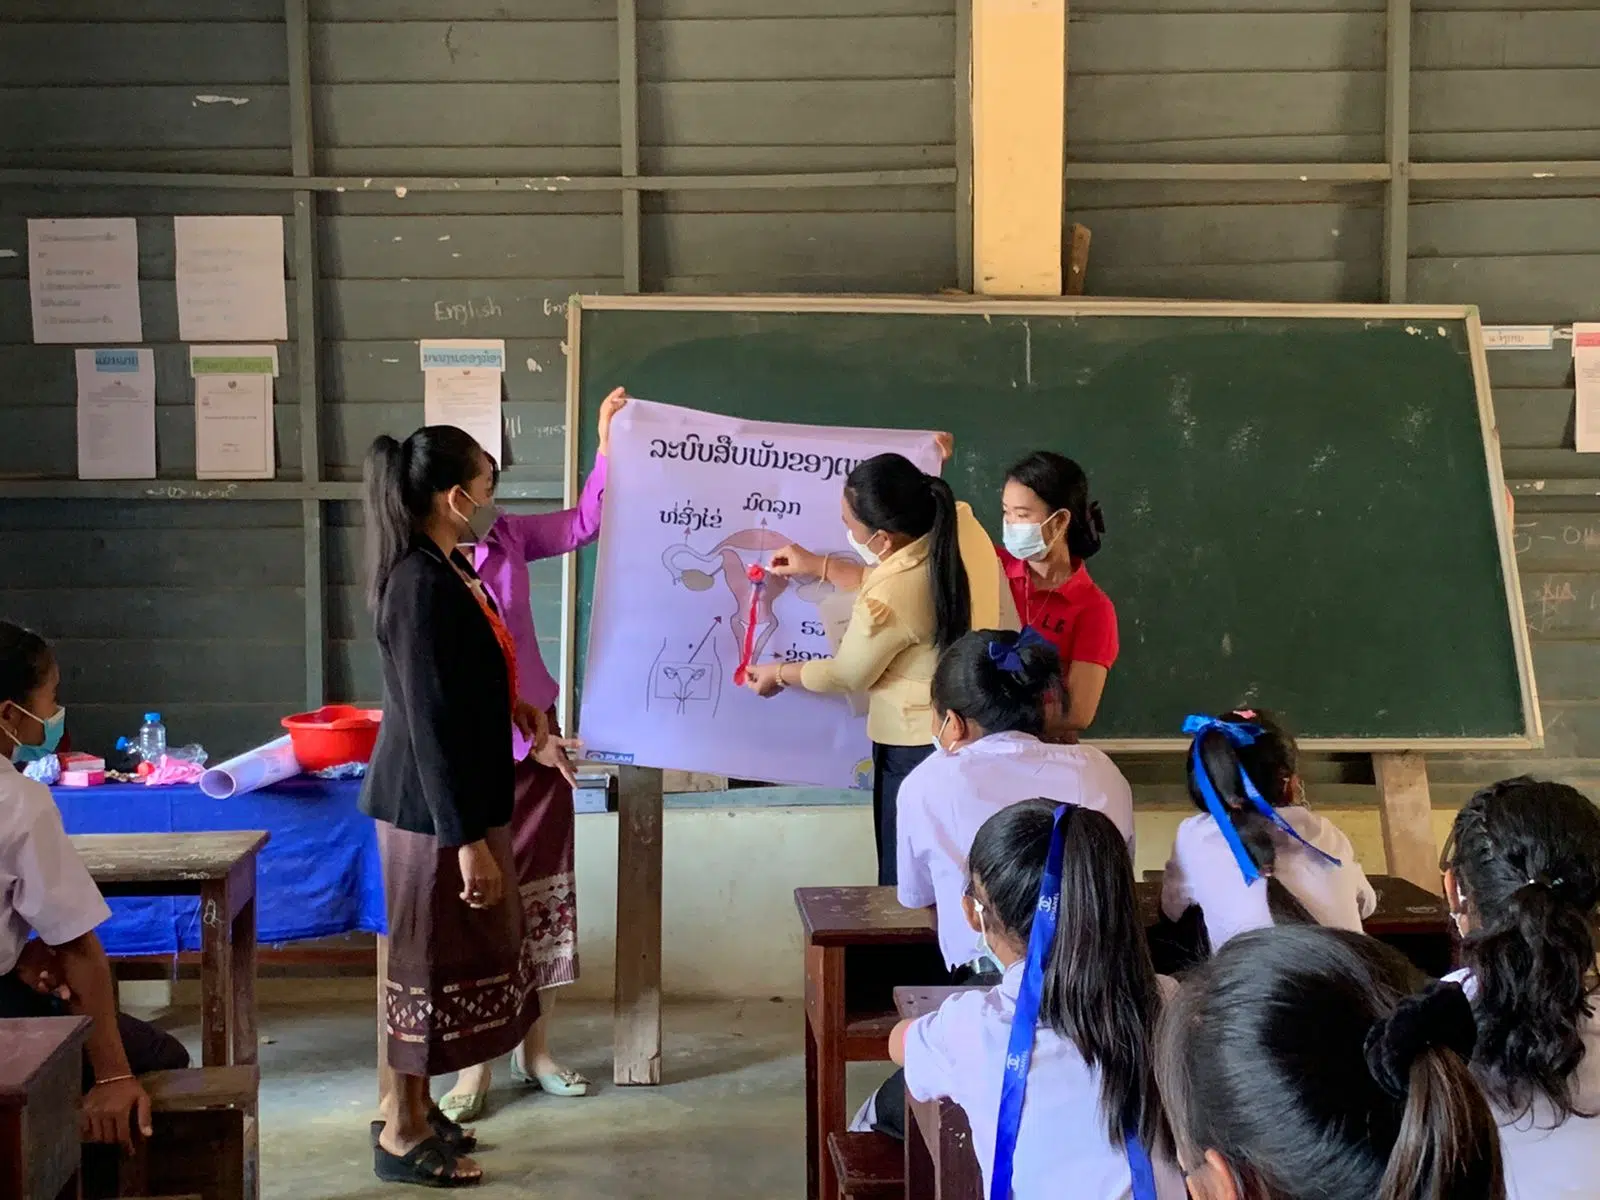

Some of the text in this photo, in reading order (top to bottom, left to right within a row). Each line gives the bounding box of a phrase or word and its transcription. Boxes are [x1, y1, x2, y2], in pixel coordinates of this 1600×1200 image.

[434, 297, 502, 326] English
[743, 492, 802, 520] ມົດລູກ
[604, 753, 633, 762] PLAN
